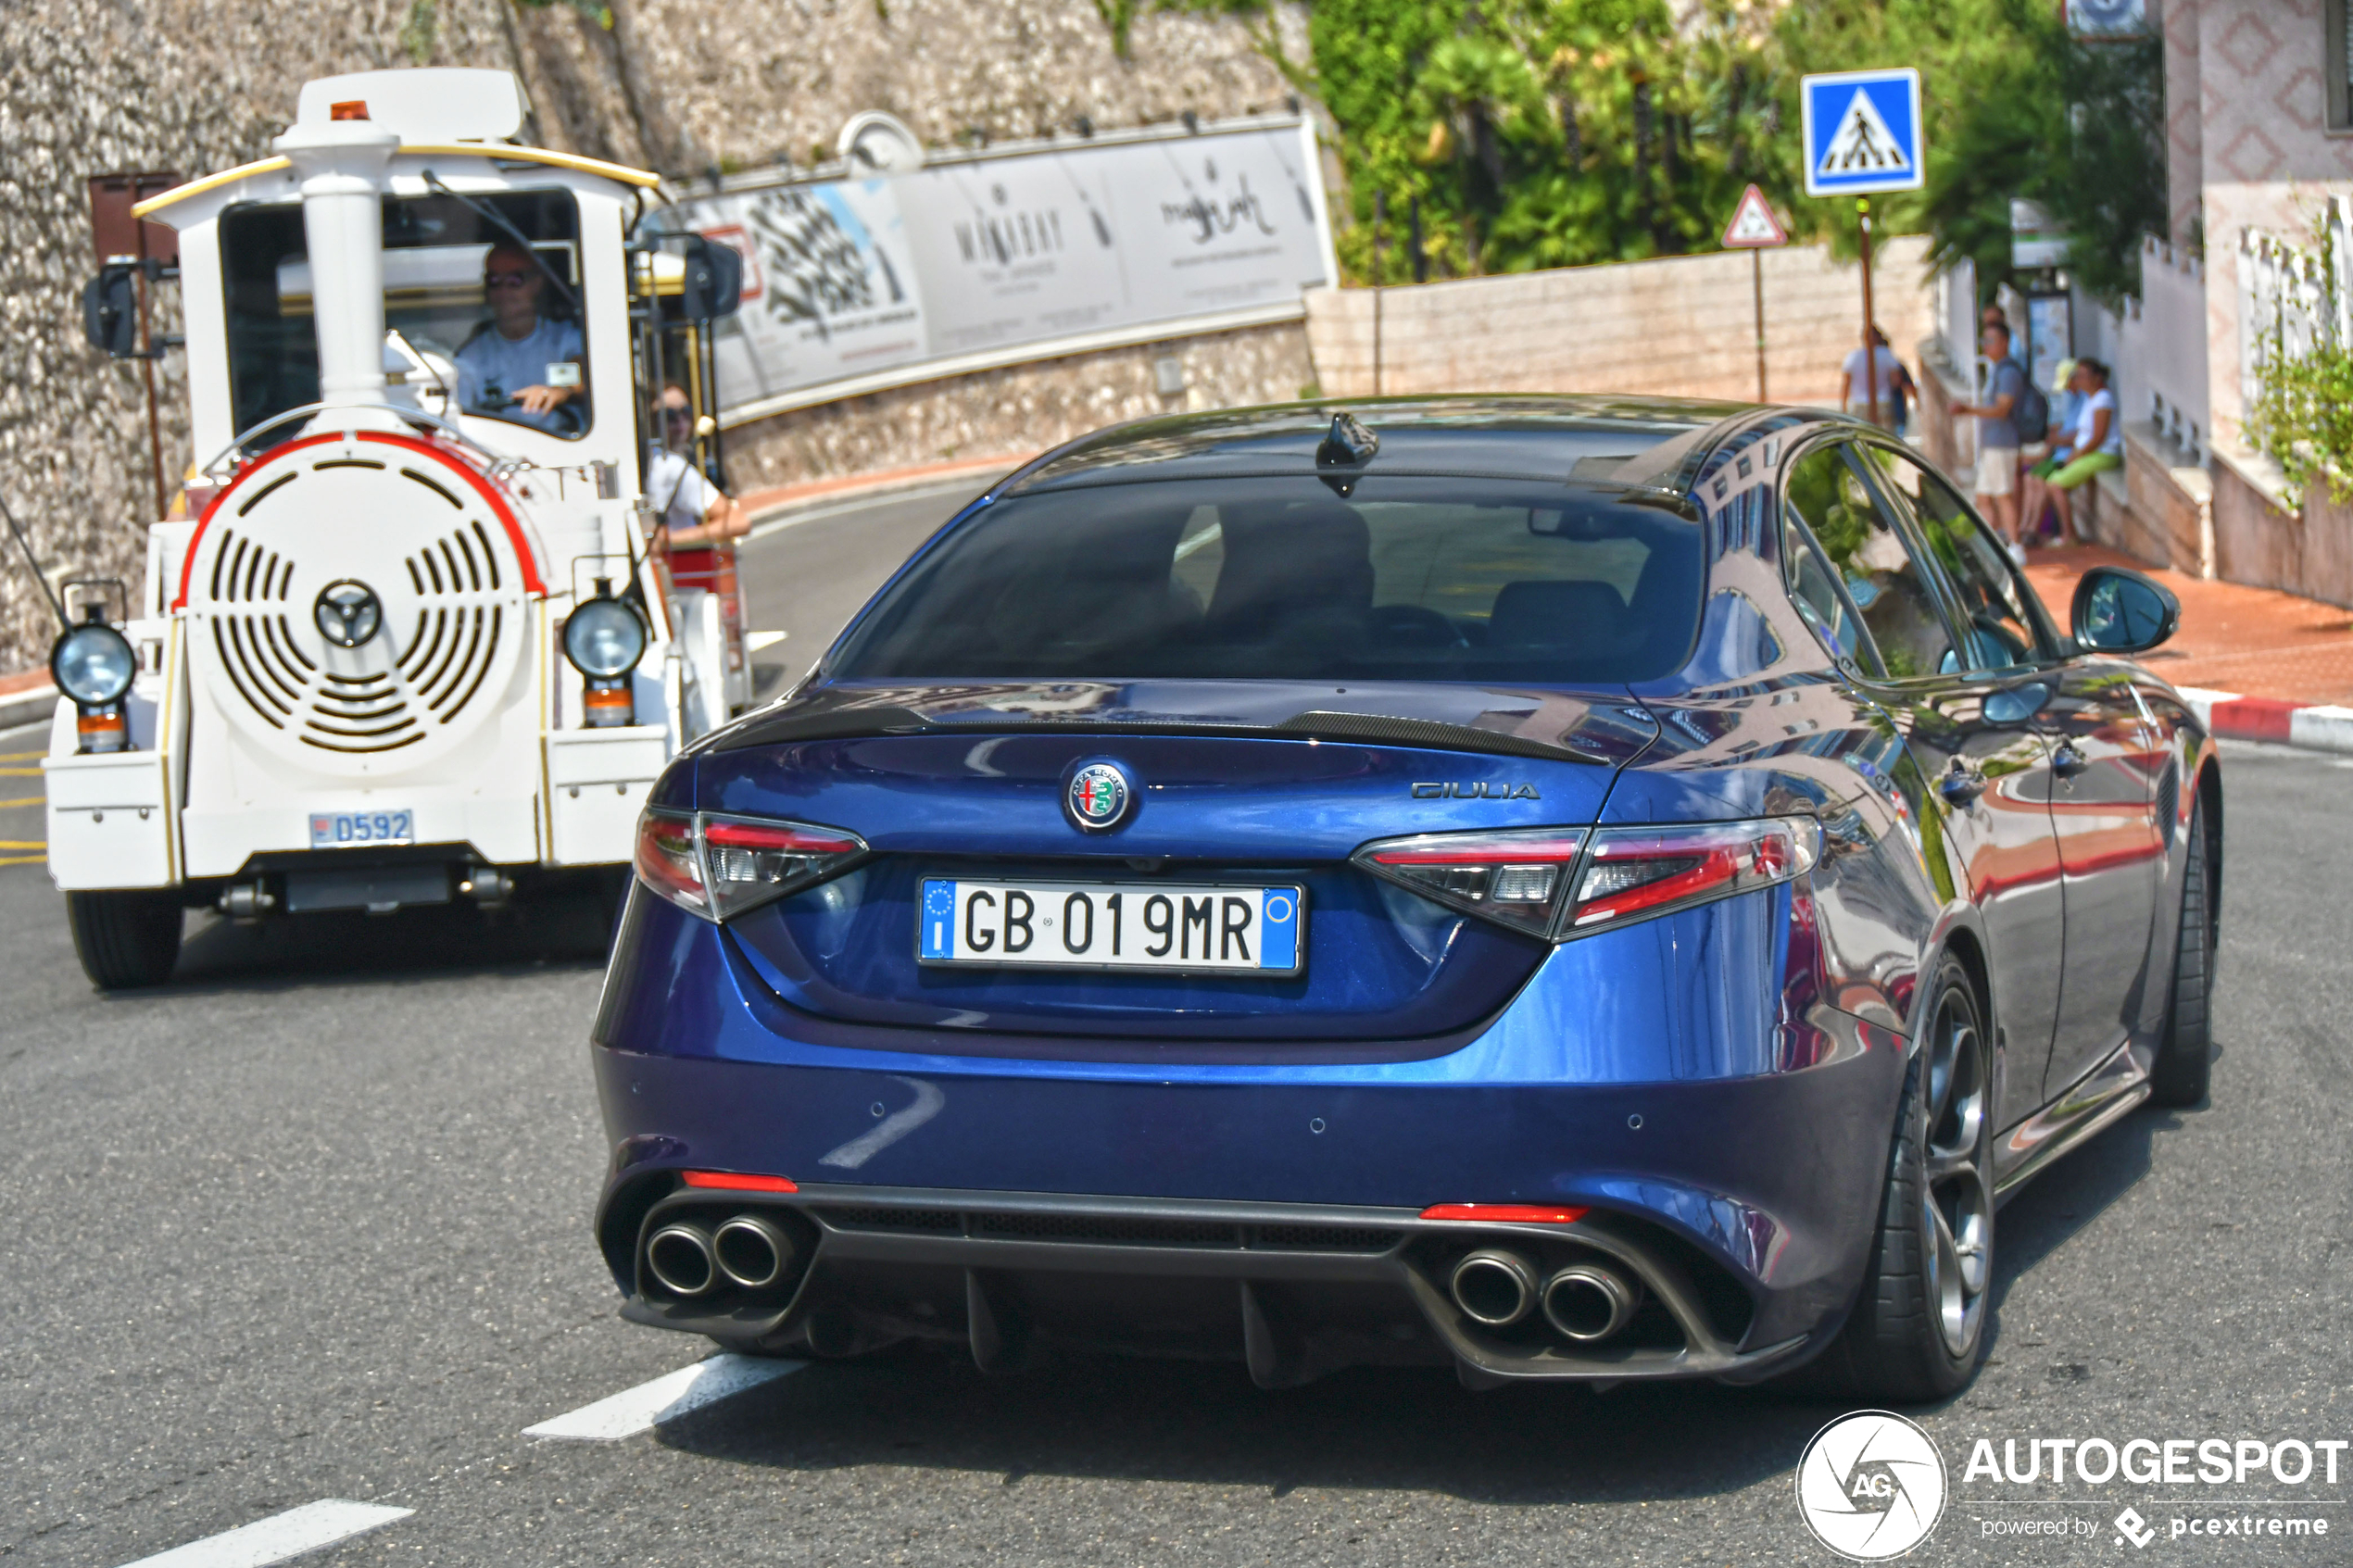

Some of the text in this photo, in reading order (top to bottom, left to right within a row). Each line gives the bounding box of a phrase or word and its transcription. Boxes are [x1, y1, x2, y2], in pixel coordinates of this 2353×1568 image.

[1074, 769, 1123, 797] ALFA ROMEO
[1411, 782, 1541, 799] GIULIA
[336, 813, 409, 842] D592
[965, 890, 1253, 960] GB 019MR
